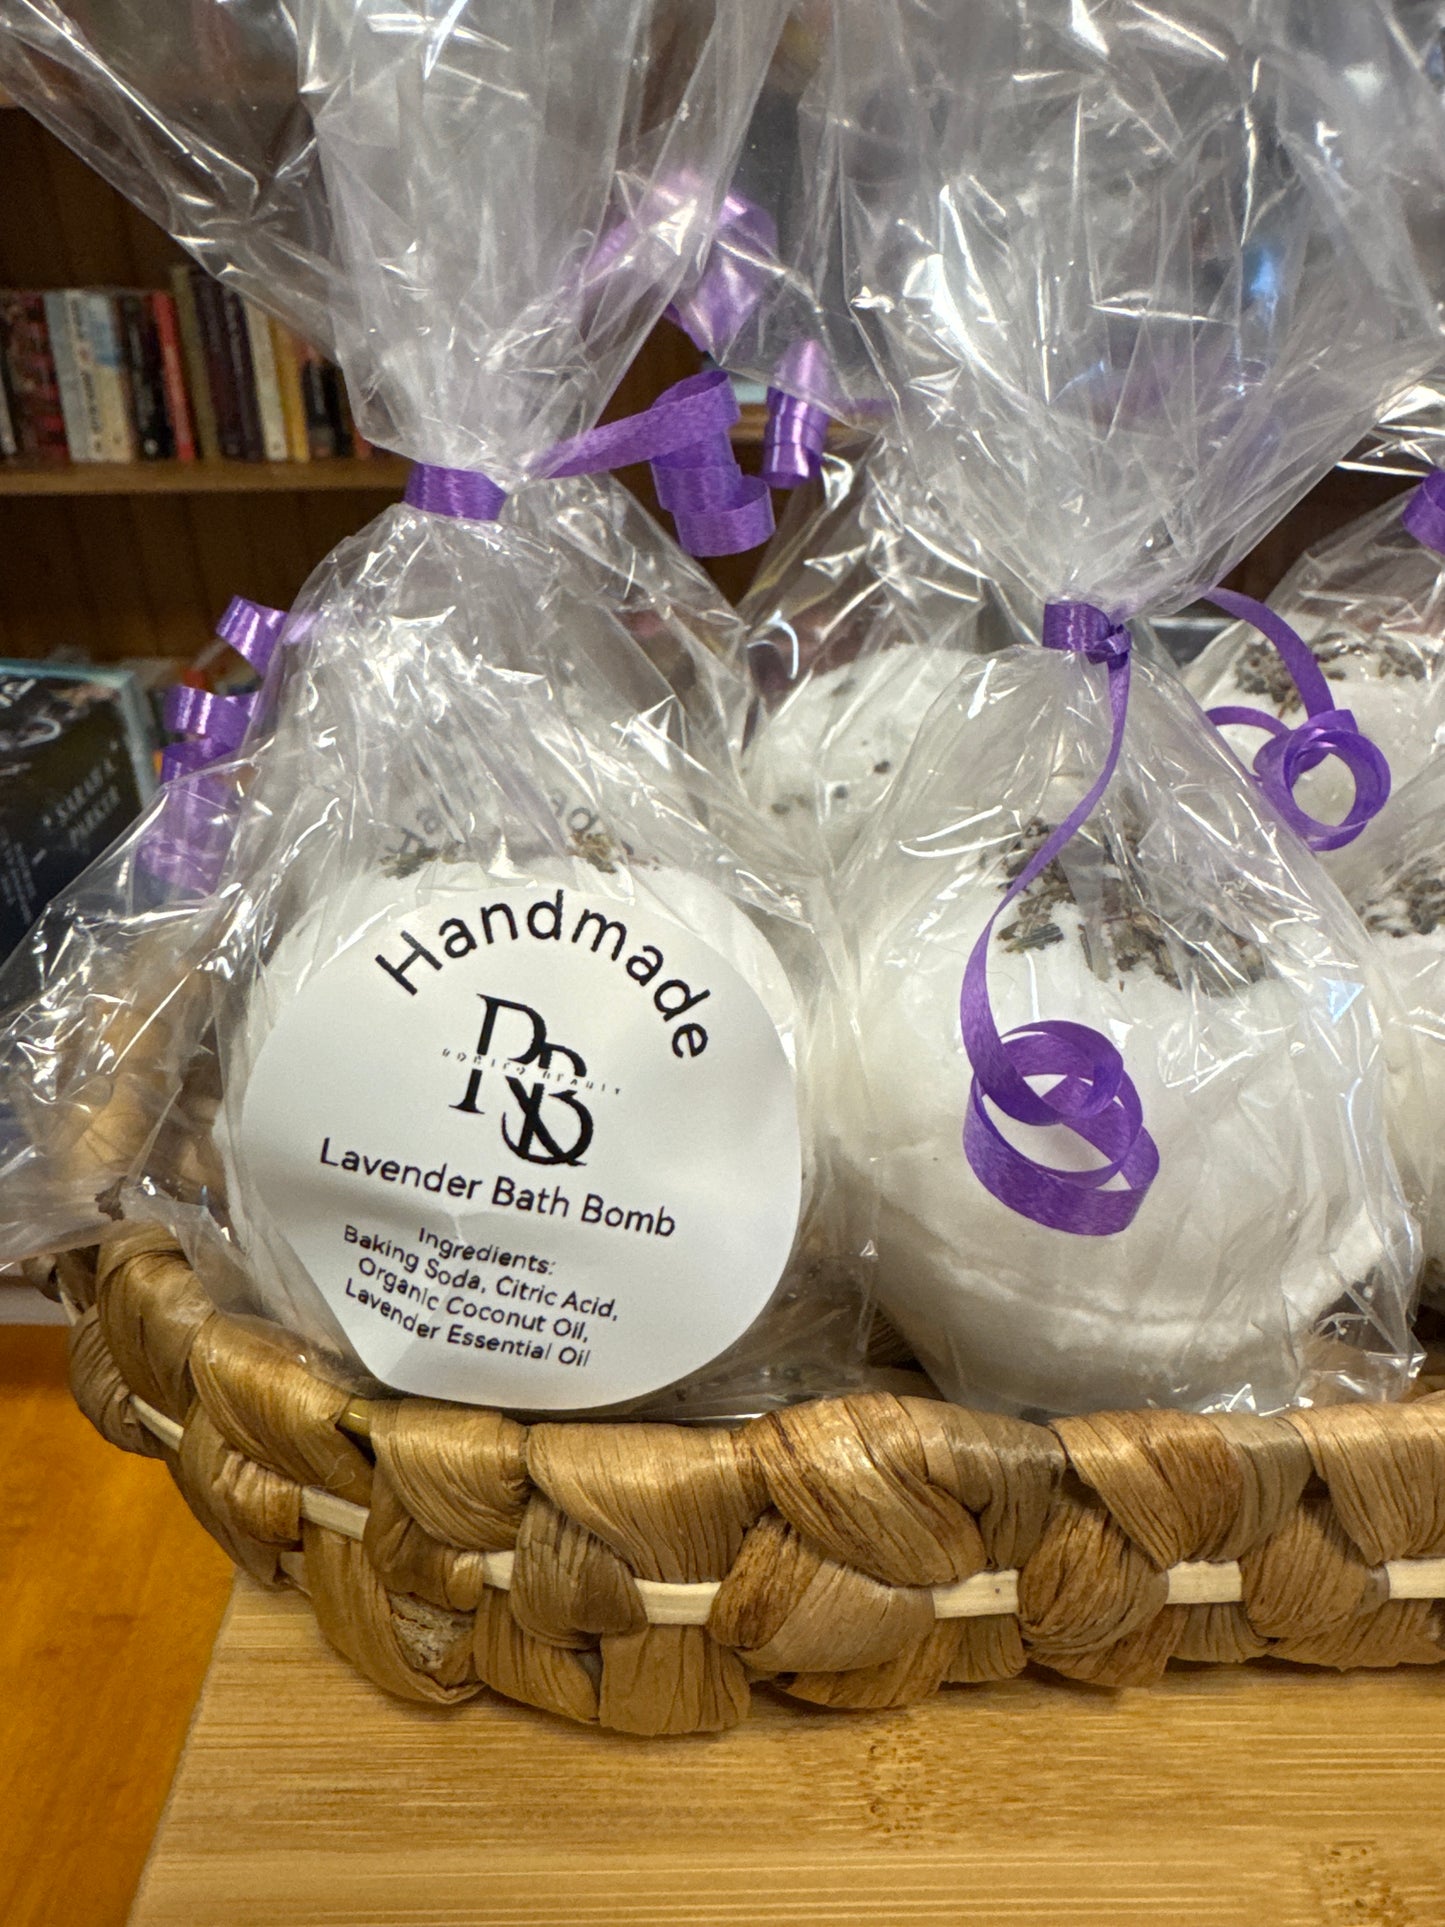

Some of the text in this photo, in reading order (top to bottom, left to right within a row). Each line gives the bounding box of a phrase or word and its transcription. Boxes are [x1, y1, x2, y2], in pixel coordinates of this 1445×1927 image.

[375, 889, 711, 1059] Handmade
[320, 1137, 675, 1237] Lavender Bath Bomb
[344, 1225, 617, 1321] Baking Soda, Citric Acid,
[419, 1228, 555, 1275] Ingredients:
[346, 1278, 590, 1366] Lavender Essential Oil
[359, 1257, 587, 1343] Organic Coconut Oil,
